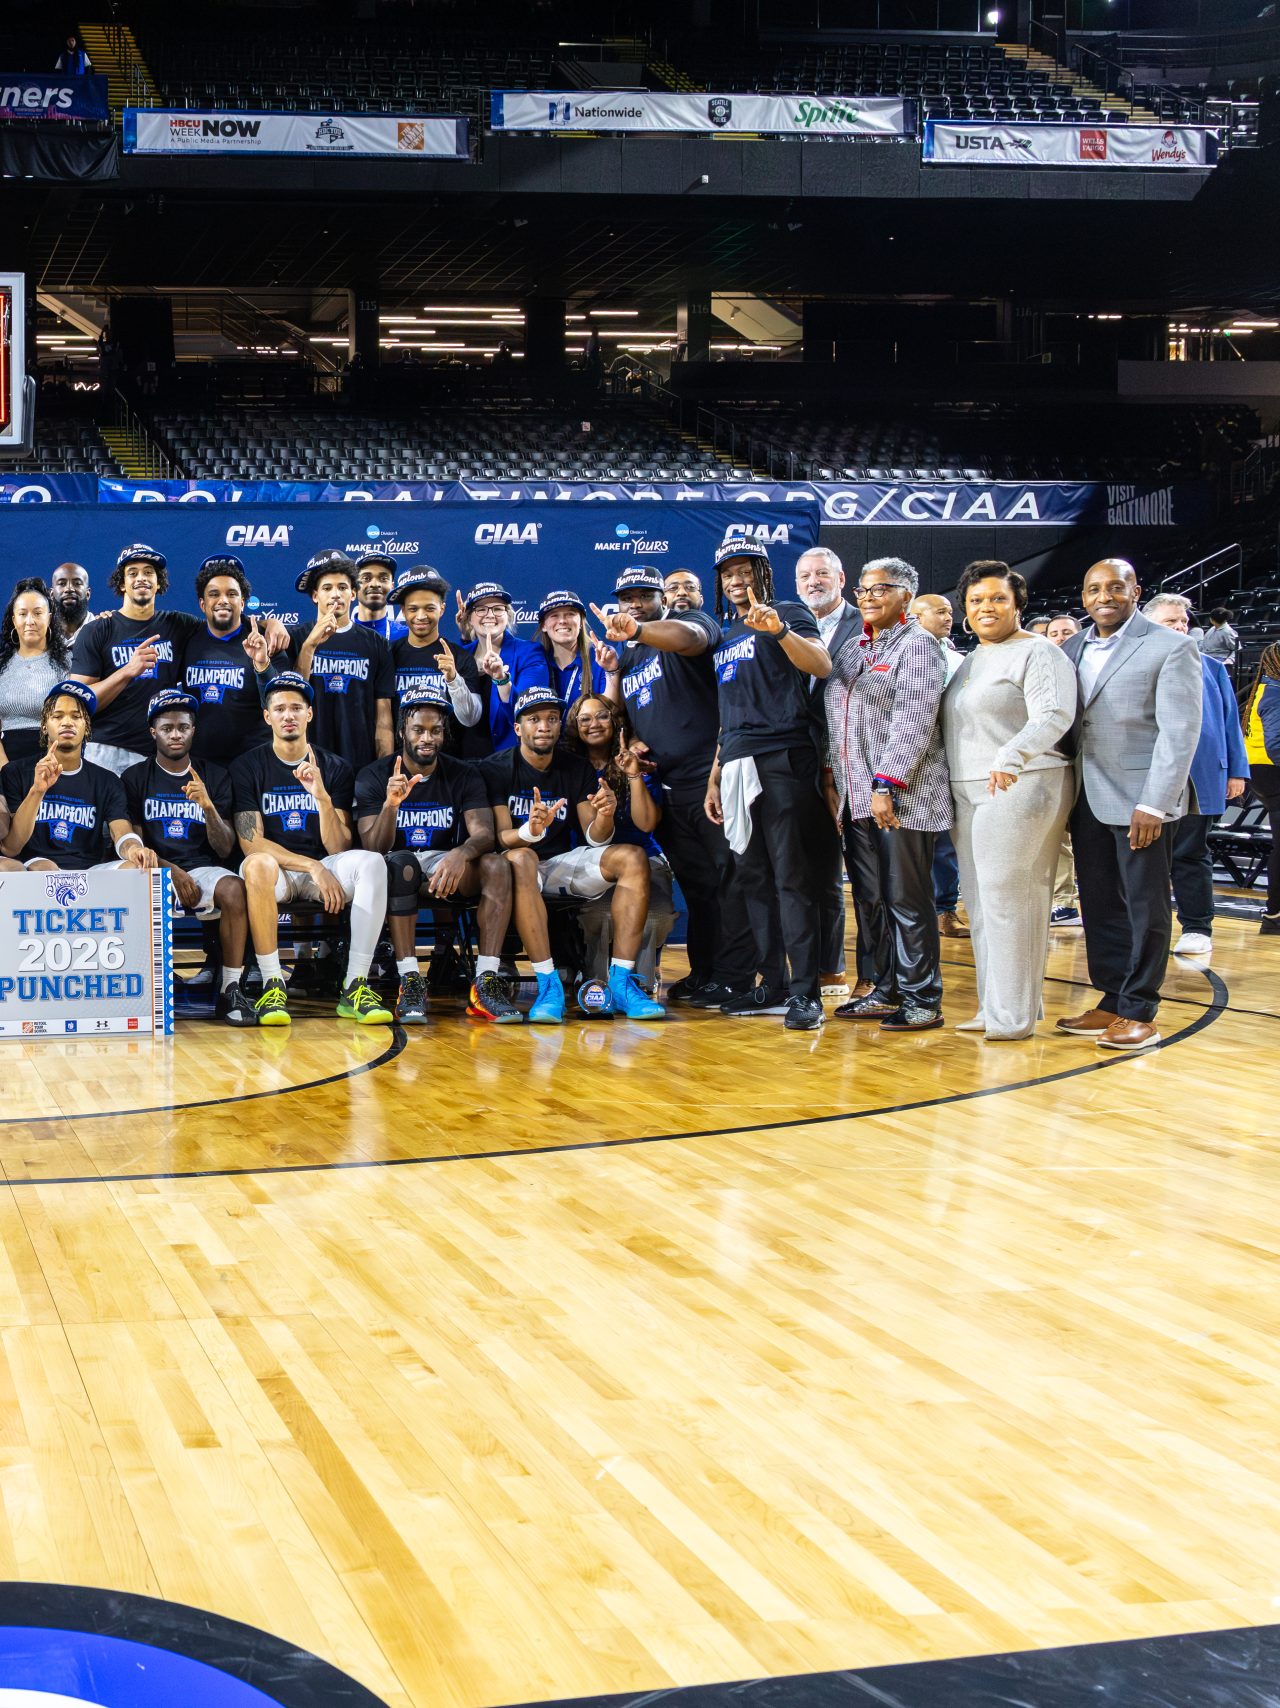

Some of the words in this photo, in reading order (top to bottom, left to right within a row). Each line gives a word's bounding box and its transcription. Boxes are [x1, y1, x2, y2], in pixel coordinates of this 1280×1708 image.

[574, 106, 642, 118] Nationwide
[794, 101, 859, 127] Sprite
[170, 119, 201, 127] HBCU
[170, 128, 201, 137] WEEK
[202, 119, 262, 138] NOW
[955, 135, 1005, 150] USTA
[1151, 147, 1186, 162] Wendy's
[359, 300, 377, 311] 115
[690, 304, 709, 314] 116
[1107, 485, 1136, 506] VISIT
[1107, 486, 1177, 526] BALTIMORE
[225, 525, 290, 547] CIAA
[474, 523, 539, 545] CIAA
[724, 523, 790, 545] CIAA
[345, 544, 371, 552] MAKE
[382, 538, 420, 554] YOURS
[594, 542, 621, 550] MAKE
[622, 542, 631, 550] IT
[632, 536, 669, 555] YOURS
[713, 635, 756, 672] HAMPIONS
[185, 665, 245, 689] CHAMPIONS
[274, 680, 306, 690] CIAA
[60, 683, 94, 702] CIAA
[158, 697, 191, 707] CIAA
[144, 798, 206, 823] CHAMPION
[262, 792, 320, 815] CHAMPION
[35, 801, 97, 828] HAMPIONS
[396, 807, 454, 829] HAMPIONS
[13, 907, 129, 935] TICKET
[17, 936, 126, 973] 2026
